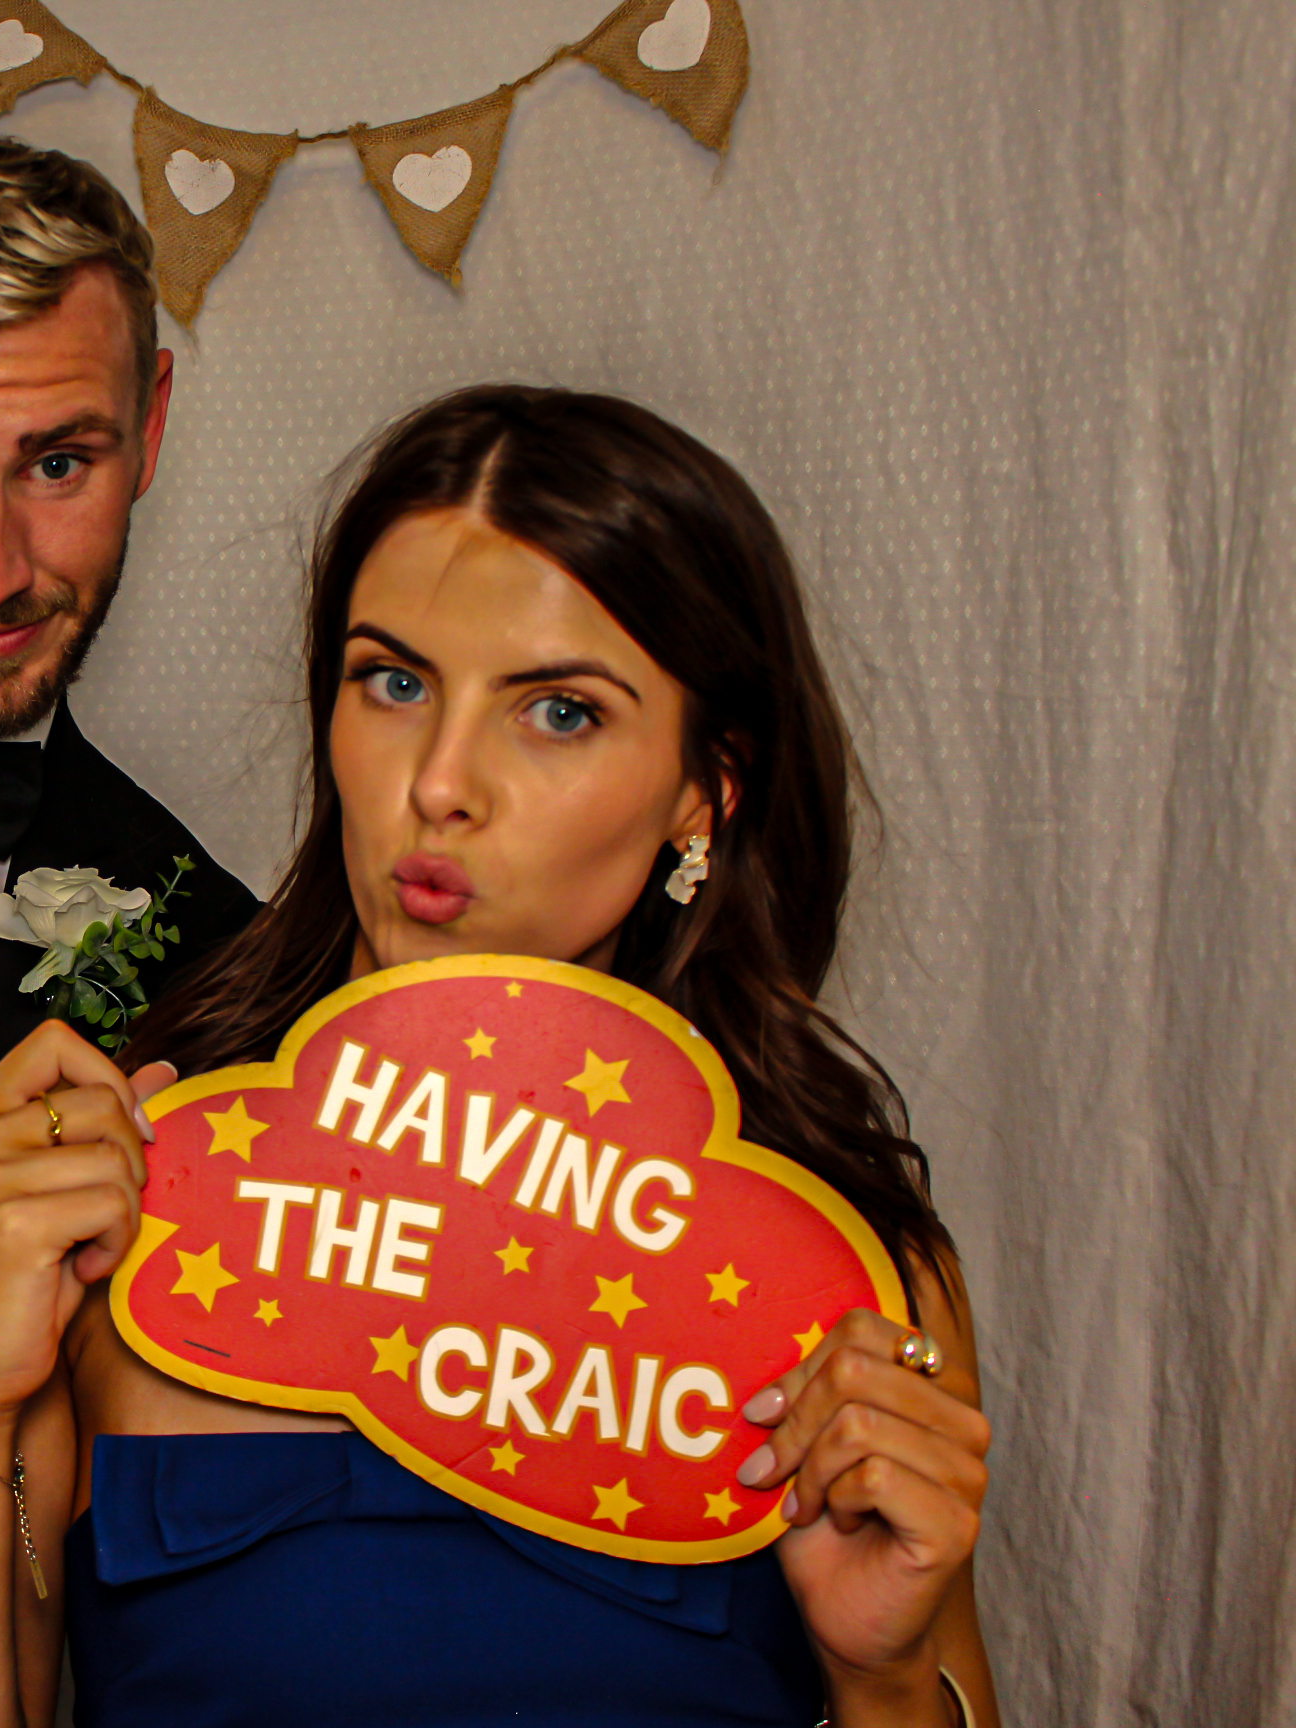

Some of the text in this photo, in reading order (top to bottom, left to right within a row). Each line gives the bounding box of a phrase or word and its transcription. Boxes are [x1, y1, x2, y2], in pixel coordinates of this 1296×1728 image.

[315, 1040, 692, 1251] HAVING
[236, 1179, 444, 1300] THE
[417, 1326, 730, 1459] CRAIC
